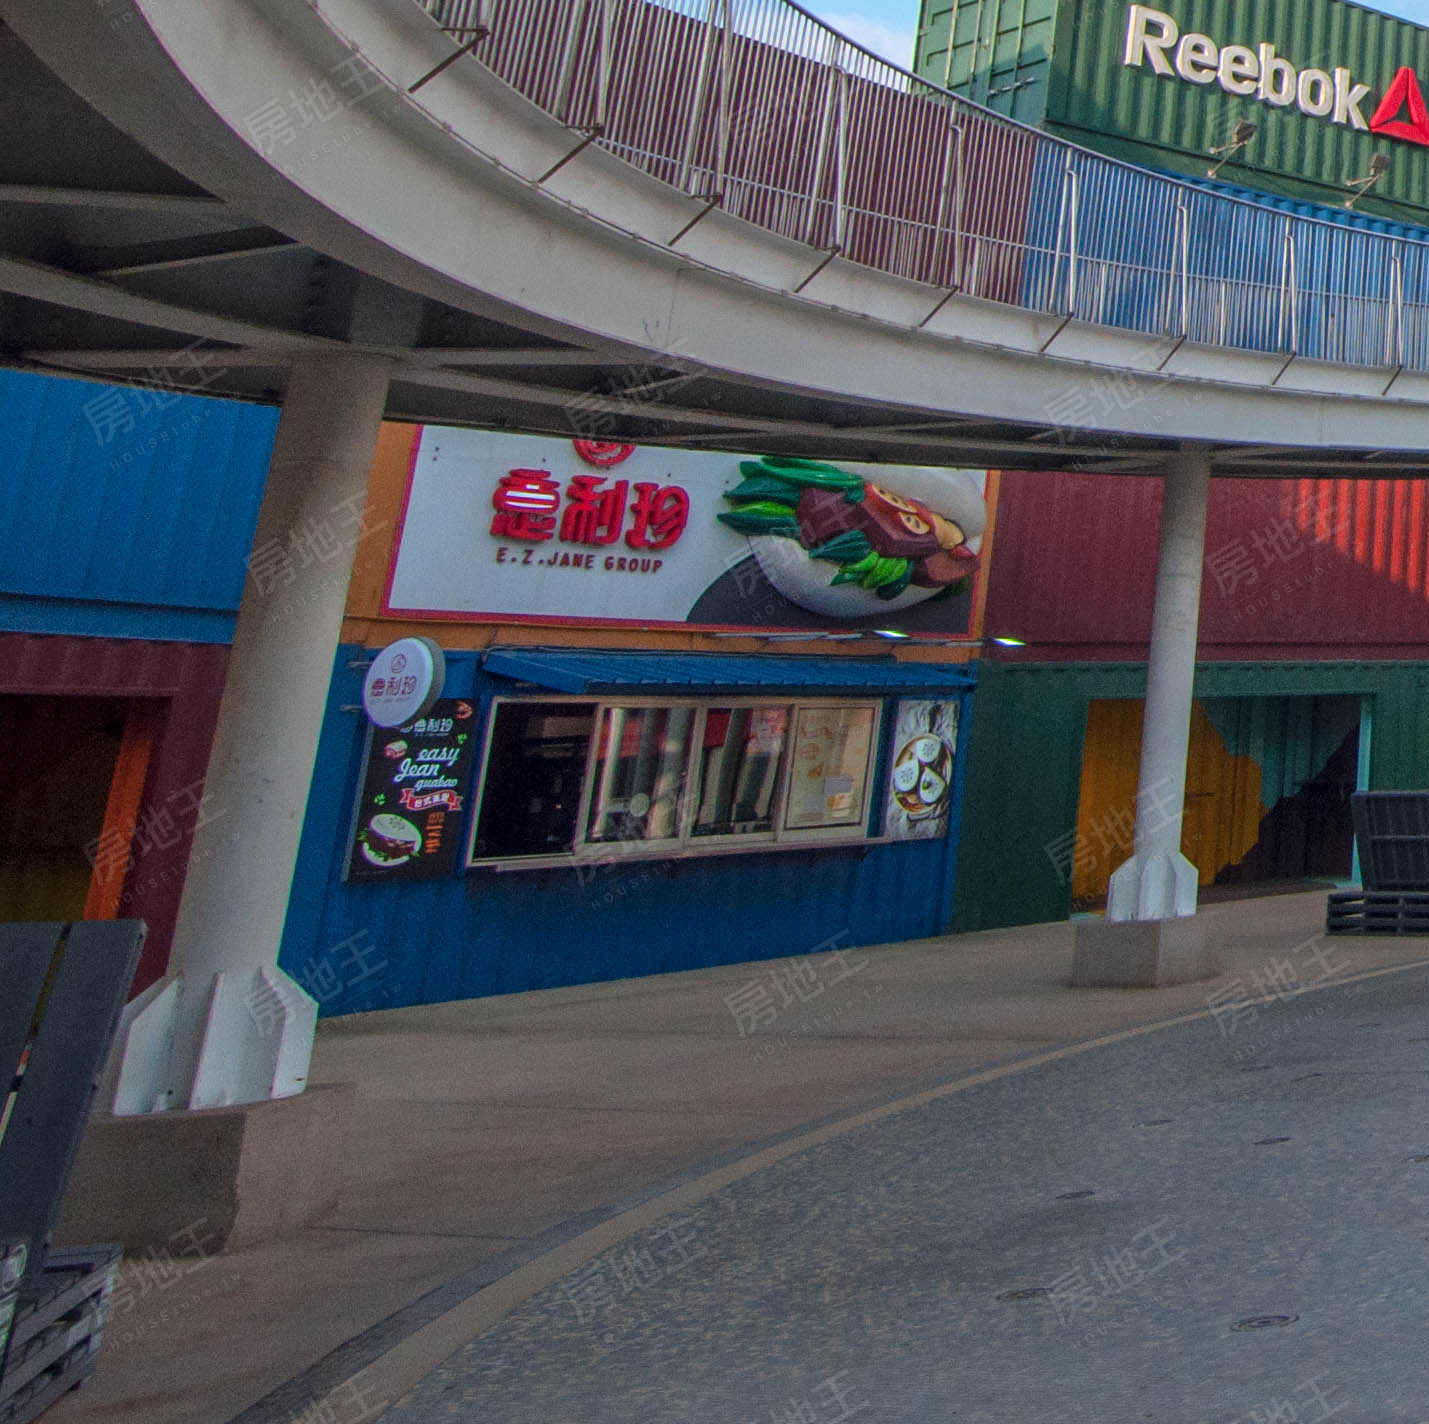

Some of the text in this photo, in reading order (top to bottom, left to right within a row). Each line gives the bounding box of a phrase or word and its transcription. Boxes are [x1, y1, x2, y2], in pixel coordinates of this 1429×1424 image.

[1122, 3, 1371, 131] Reebok
[496, 546, 664, 574] E.Z.JANE GROUP
[416, 746, 461, 768] easy
